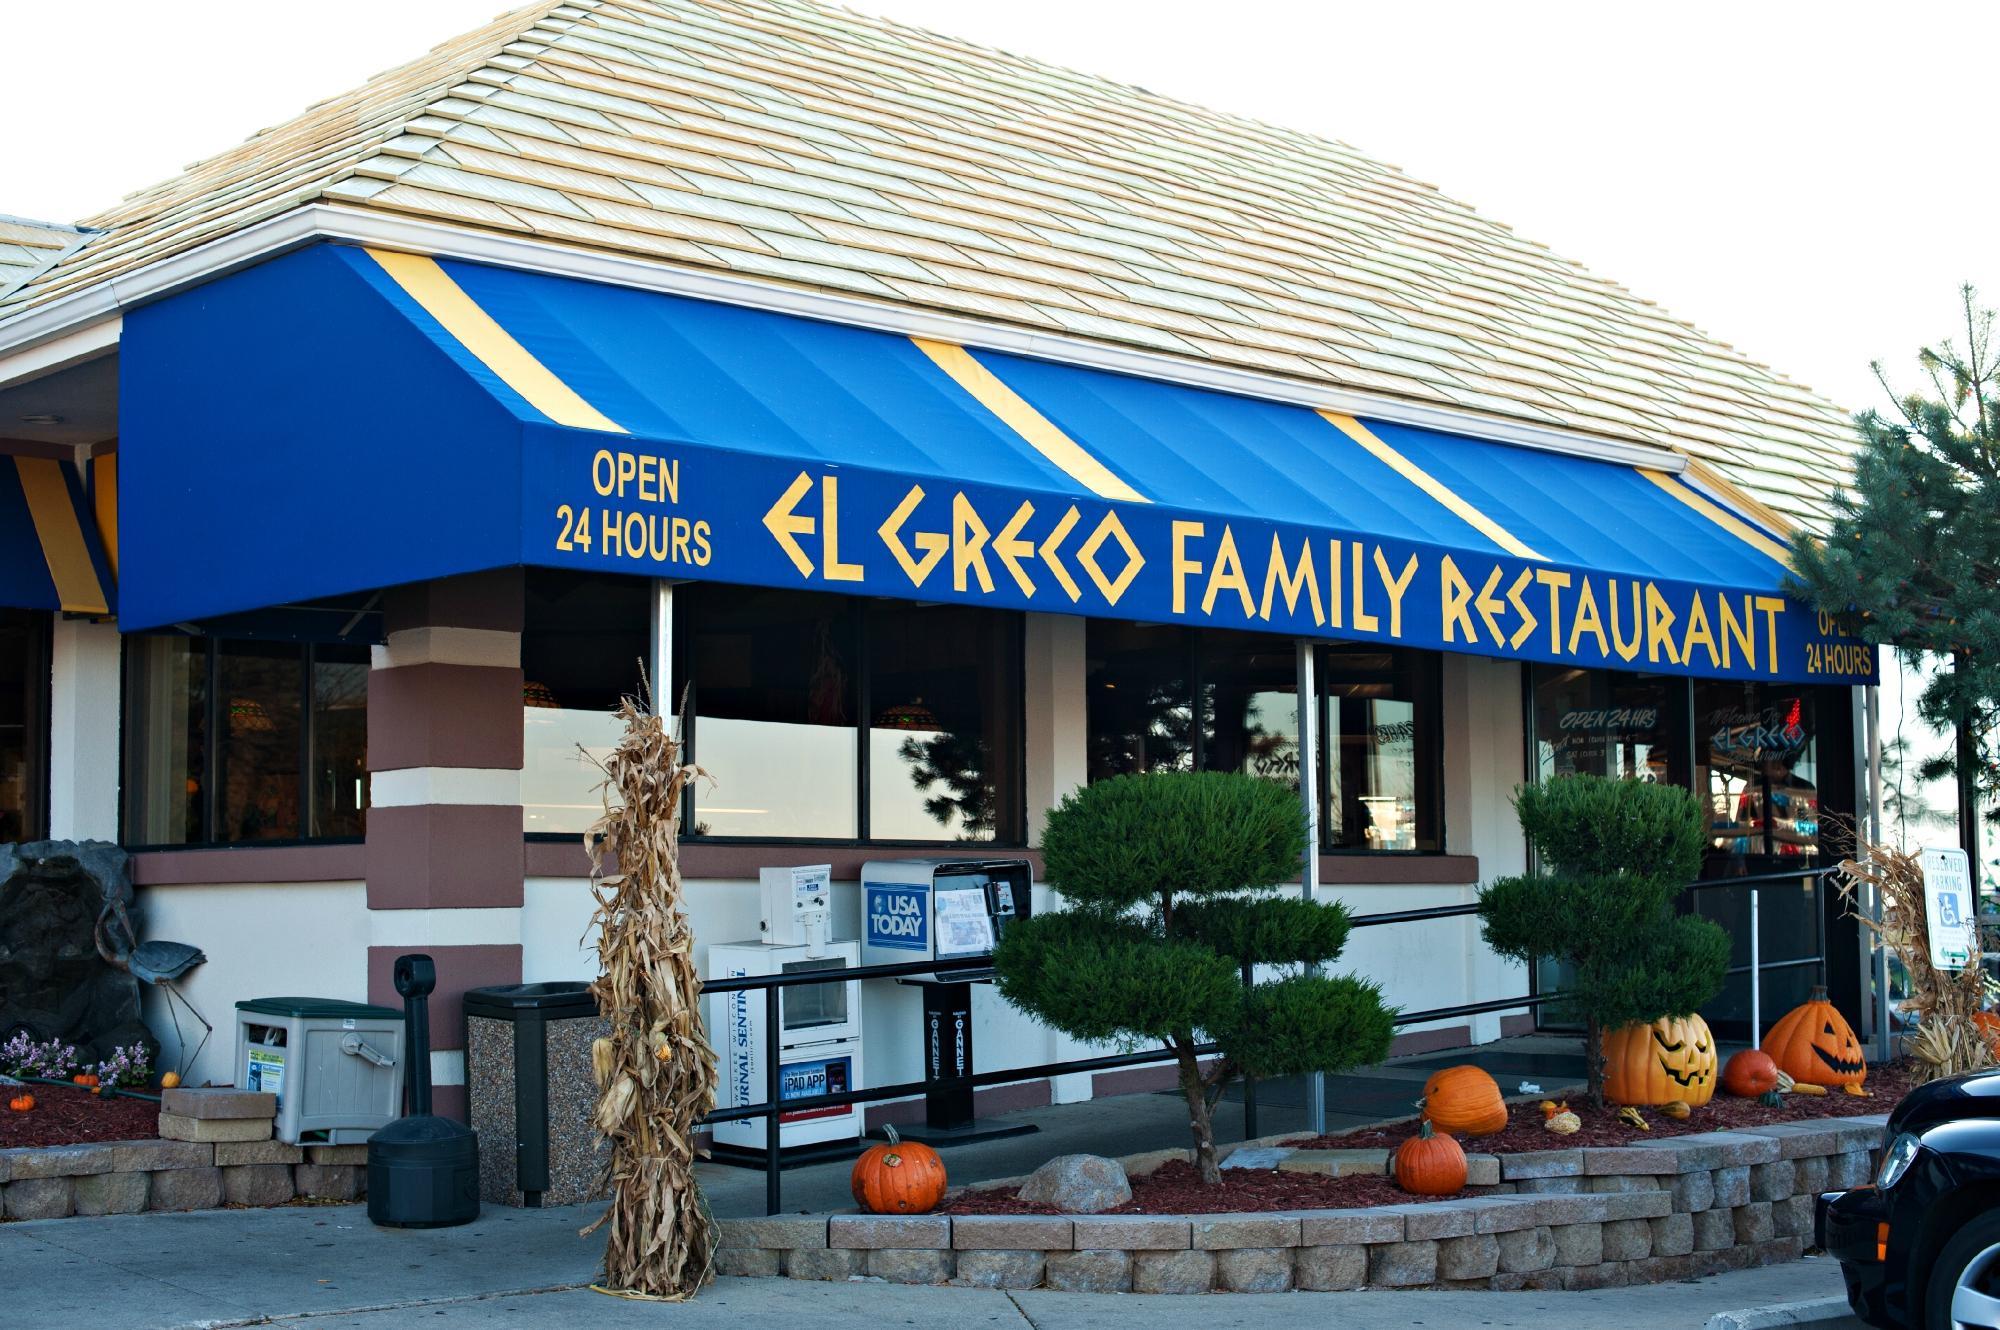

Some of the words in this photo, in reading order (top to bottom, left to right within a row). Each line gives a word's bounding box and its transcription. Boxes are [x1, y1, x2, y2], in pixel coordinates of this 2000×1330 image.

[592, 449, 679, 504] OPEN
[556, 504, 591, 553] 24
[602, 510, 712, 567] HOURS
[762, 470, 864, 582] EL
[877, 484, 1146, 607] GRECO
[1172, 521, 1419, 638] FAMILY
[1441, 553, 1786, 674] RESTAURANT
[1818, 606, 1850, 637] OP
[1806, 643, 1822, 673] 24
[1824, 644, 1872, 676] HOURS
[1560, 710, 1607, 729] OPEN
[1607, 709, 1632, 728] 24
[1630, 708, 1657, 728] HRS
[1712, 726, 1737, 751] EL
[1738, 722, 1806, 750] GRECO
[1926, 855, 1963, 873] RESERVED
[1931, 874, 1963, 891] PARKING
[887, 894, 921, 916] USA
[871, 913, 923, 937] TODAY
[736, 967, 748, 1048] SENTINL
[955, 1019, 965, 1078] GANNET
[738, 1051, 752, 1129] JURNAL
[785, 1076, 805, 1093] iPAD
[807, 1074, 825, 1089] APP
